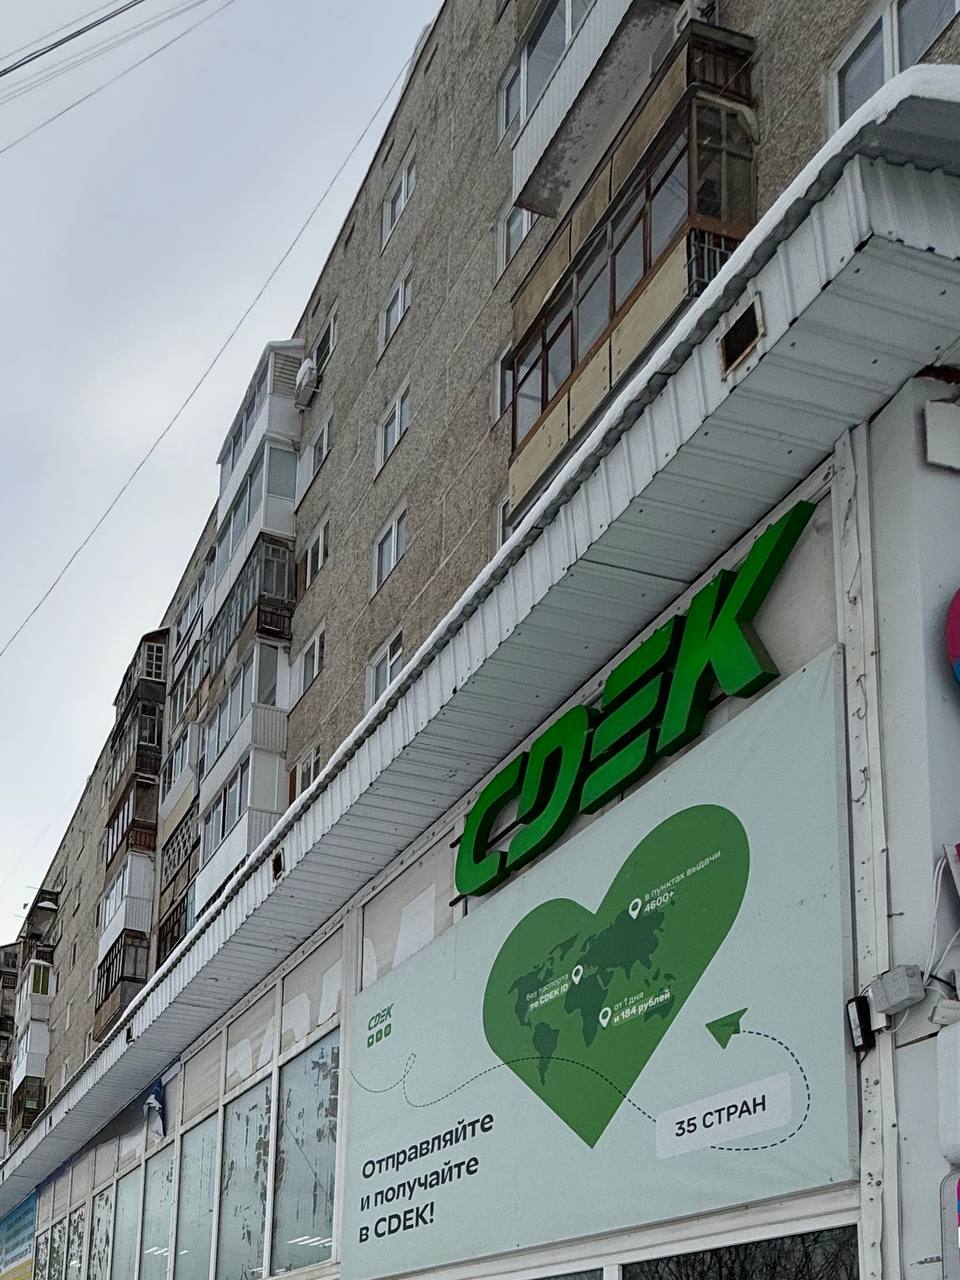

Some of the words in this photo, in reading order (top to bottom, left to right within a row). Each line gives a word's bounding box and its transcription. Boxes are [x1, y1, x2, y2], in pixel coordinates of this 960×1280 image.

[455, 500, 818, 896] CDEK
[651, 872, 686, 898] пунктах
[686, 850, 722, 877] выдачи
[643, 890, 675, 913] 4600+
[538, 973, 569, 994] паспорта
[539, 988, 560, 1004] CDEK
[560, 983, 569, 993] ID
[613, 1001, 623, 1011] от
[628, 991, 645, 1007] дня
[368, 1003, 394, 1031] CDEK
[613, 1015, 620, 1024] и
[620, 1005, 637, 1020] 184
[638, 989, 671, 1015] рублей
[675, 1116, 697, 1136] 35
[702, 1094, 766, 1129] СТРАН
[361, 1112, 494, 1179] Отправляйте
[360, 1194, 371, 1212] и
[374, 1156, 480, 1207] получайте
[358, 1225, 370, 1243] в
[374, 1201, 435, 1239] CDEK!
